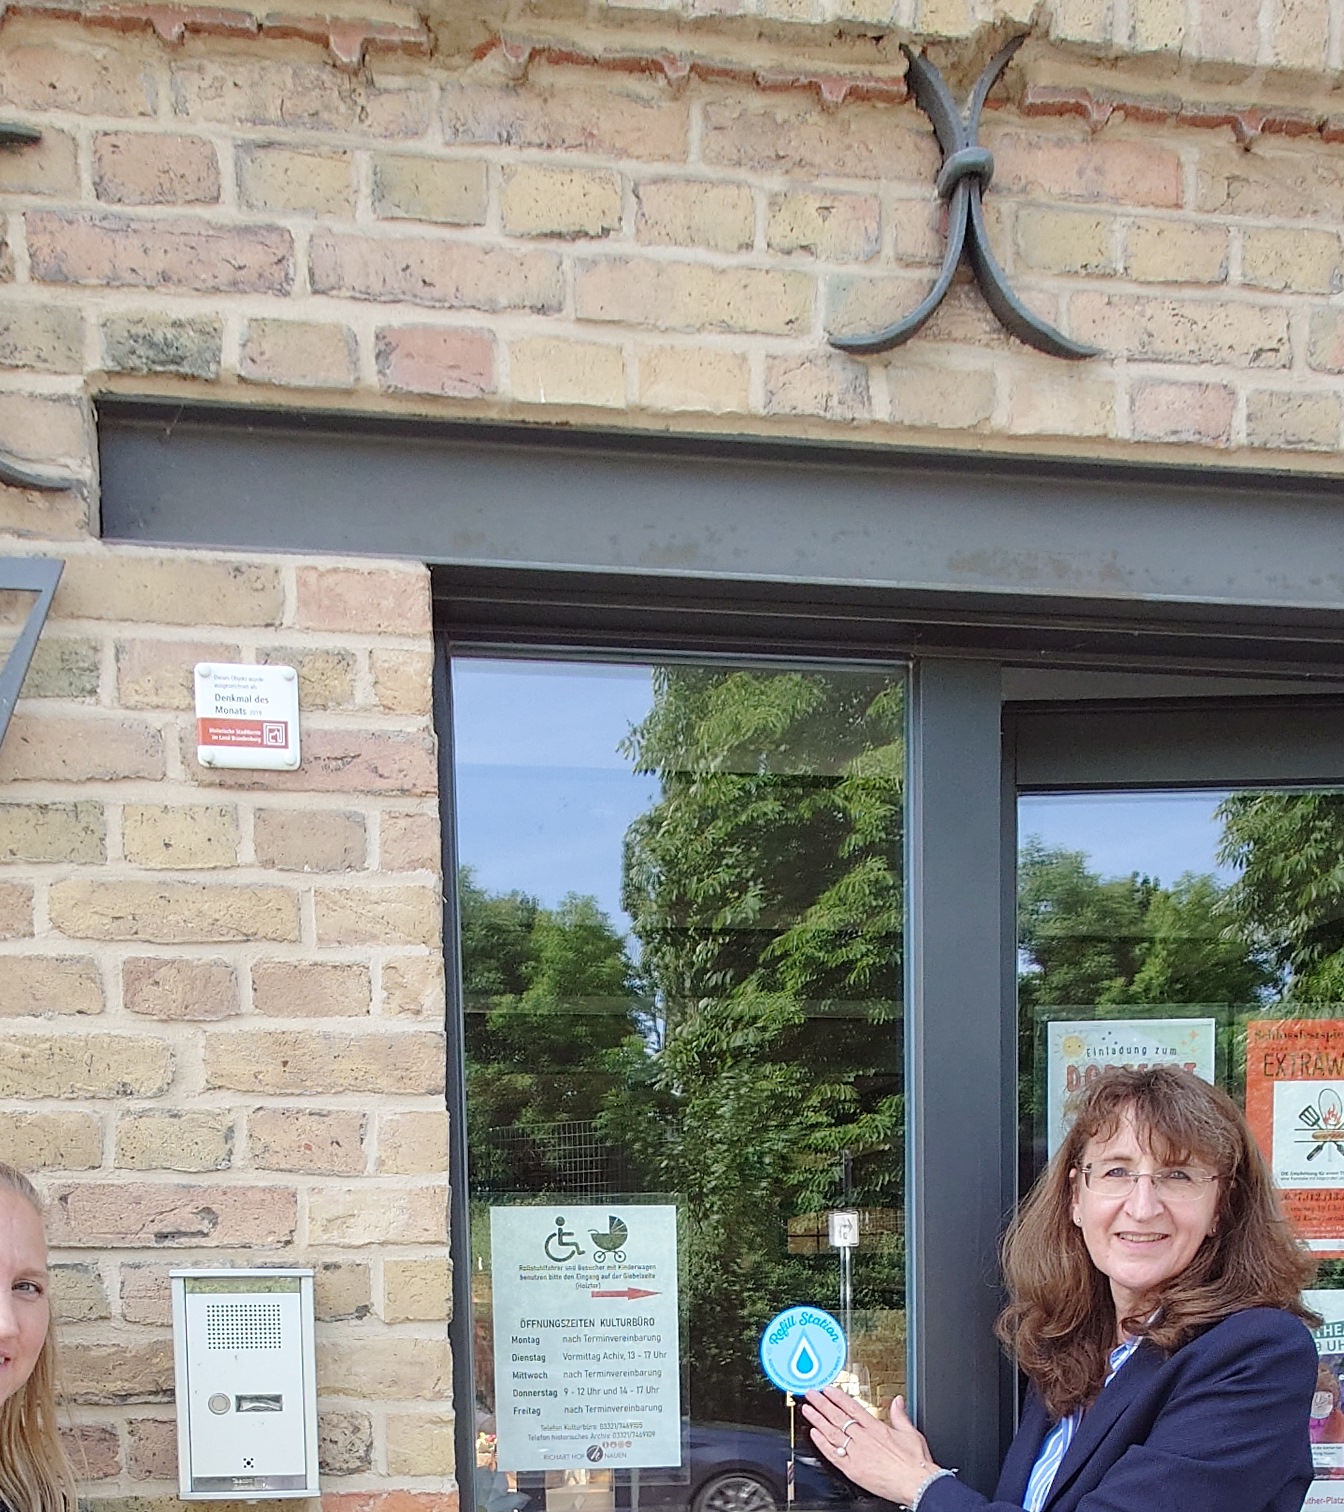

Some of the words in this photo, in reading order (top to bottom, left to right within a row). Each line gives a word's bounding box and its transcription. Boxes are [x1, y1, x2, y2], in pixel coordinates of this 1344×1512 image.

[215, 693, 252, 703] Denkmal
[254, 696, 270, 704] des
[215, 706, 247, 716] Monats
[1086, 1046, 1147, 1058] Einladung
[1155, 1048, 1177, 1056] zum
[618, 1264, 656, 1272] Kinderwagen
[576, 1273, 600, 1282] Eingang
[600, 1272, 610, 1280] auf
[612, 1272, 622, 1280] der
[623, 1272, 656, 1280] Giebelseite
[520, 1318, 595, 1328] ÖFFNUNGSZEITEN
[600, 1317, 655, 1328] KULTURBÜRO
[768, 1316, 796, 1344] Refill
[798, 1312, 840, 1342] Station
[512, 1336, 540, 1346] Montag
[562, 1336, 582, 1344] nach
[584, 1334, 662, 1344] Terminvereinbarung
[512, 1354, 546, 1363] Dienstag
[562, 1352, 600, 1362] Vormittag
[602, 1352, 626, 1361] Achiv,
[628, 1352, 636, 1360] 13
[644, 1351, 651, 1359] 17
[654, 1350, 668, 1359] Uhr
[512, 1371, 548, 1380] Mittwoch
[564, 1370, 582, 1378] nach
[584, 1368, 662, 1379] Terminvereinbarung
[512, 1388, 558, 1398] Donnerstag
[564, 1388, 568, 1396] 9
[578, 1388, 585, 1396] 12
[587, 1387, 601, 1396] Uhr
[603, 1387, 618, 1395] und
[620, 1386, 628, 1394] 14
[636, 1386, 644, 1394] 17
[646, 1386, 660, 1394] Uhr
[514, 1406, 541, 1416] Freitag
[564, 1405, 584, 1414] nach
[586, 1404, 663, 1414] Terminvereinbarung
[528, 1434, 550, 1442] Telefon
[551, 1432, 588, 1440] historisches
[1304, 1496, 1344, 1504] uther-Platz
